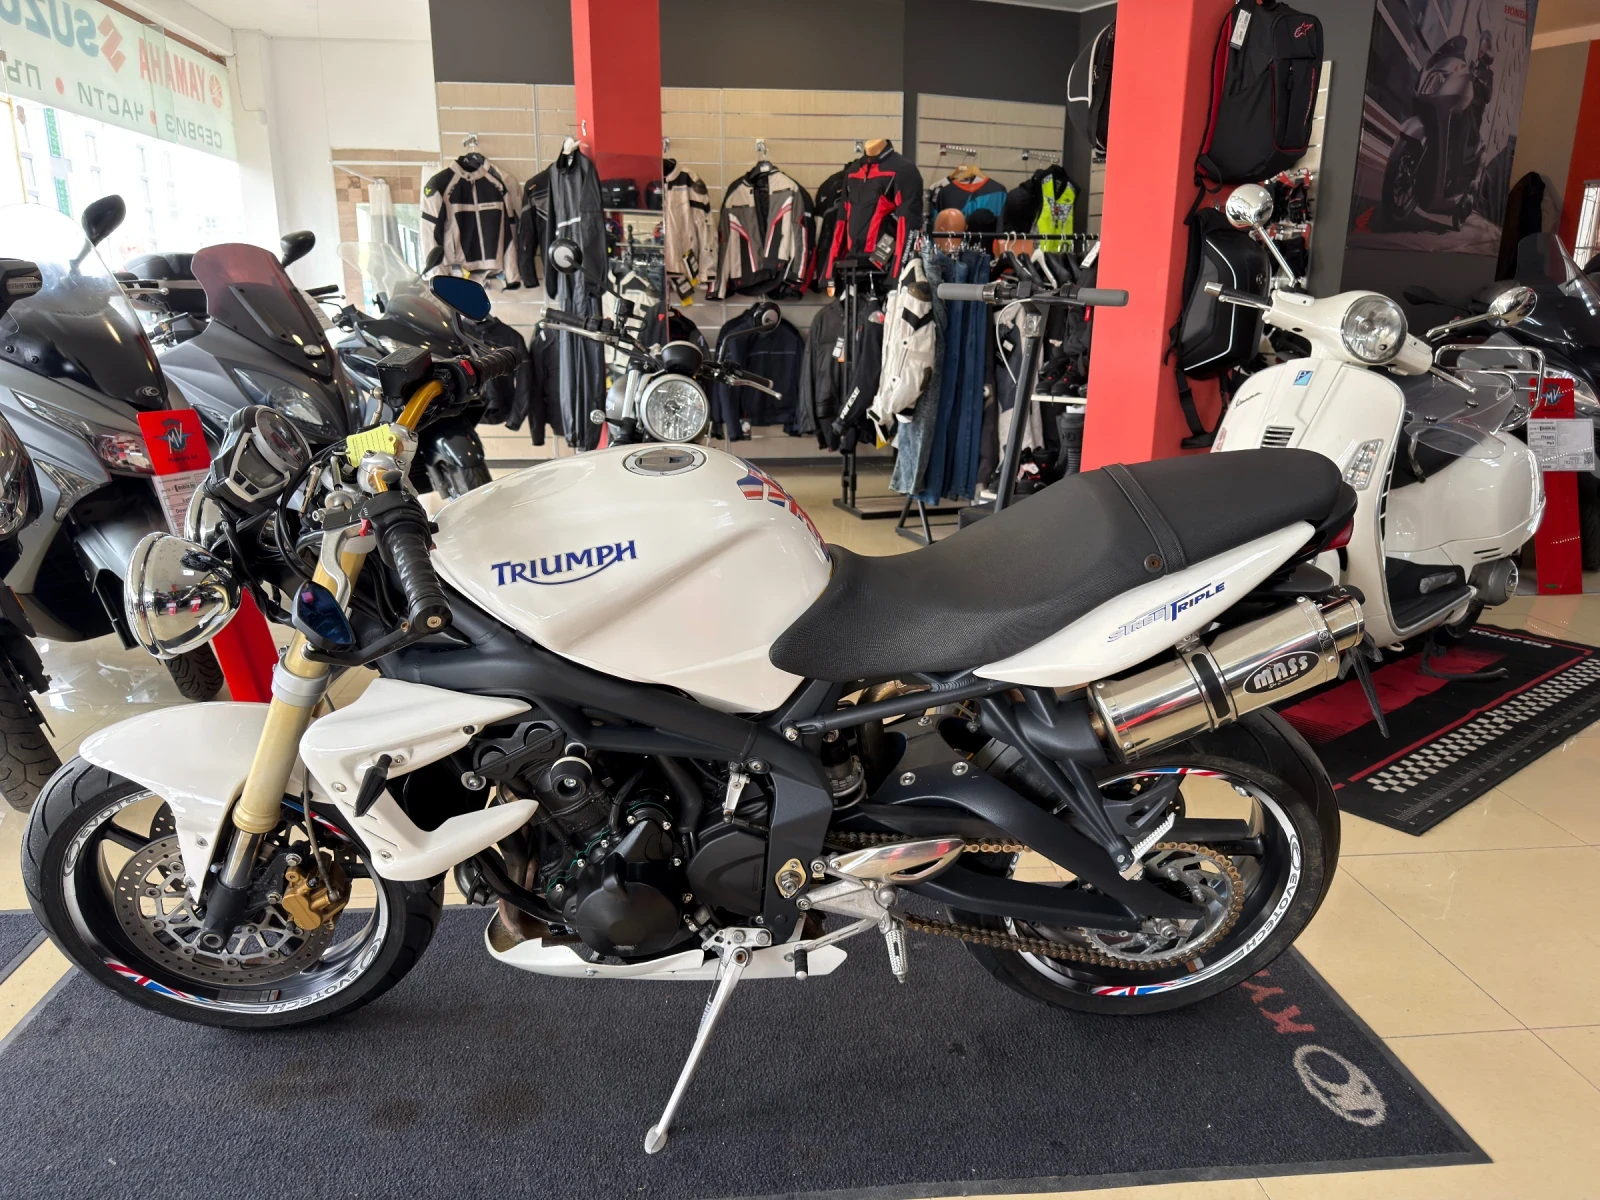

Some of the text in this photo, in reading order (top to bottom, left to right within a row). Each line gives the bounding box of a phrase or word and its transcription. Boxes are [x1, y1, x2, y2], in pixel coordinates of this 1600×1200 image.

[491, 539, 637, 586] TRIUMPH
[1170, 582, 1225, 621] TRIPLE
[1469, 628, 1521, 642] OXFOR
[80, 789, 157, 838] EVOTEC
[1246, 872, 1298, 952] EVOTECH
[270, 969, 359, 1013] EVOTECH
